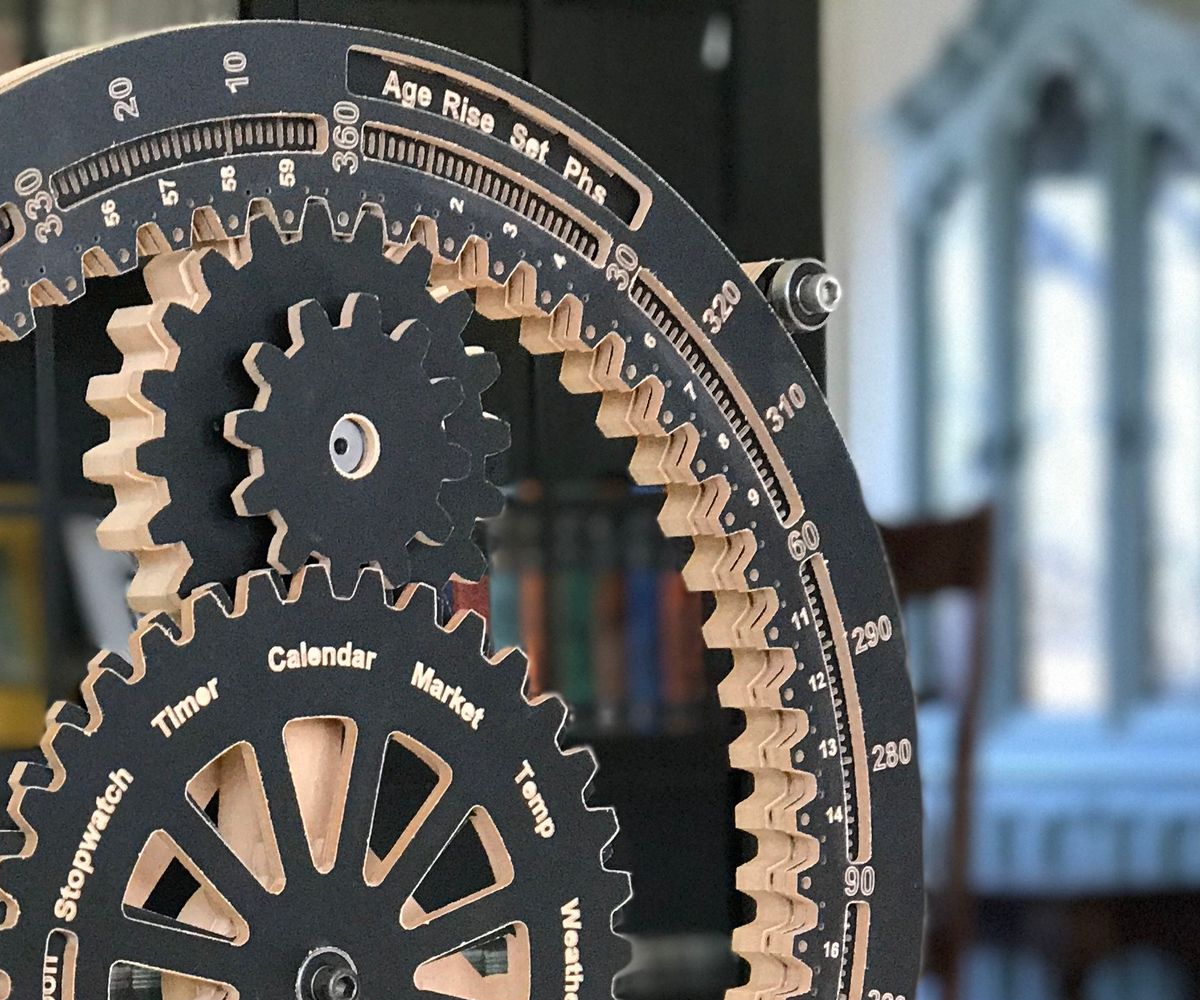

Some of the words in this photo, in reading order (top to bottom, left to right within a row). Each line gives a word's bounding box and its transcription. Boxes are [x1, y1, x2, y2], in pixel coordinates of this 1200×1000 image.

[223, 51, 249, 94] 10
[108, 76, 139, 122] 20
[332, 100, 360, 175] 360
[382, 70, 432, 109] Age
[442, 89, 495, 134] Rise
[510, 123, 549, 165] Set
[563, 155, 608, 206] Phs
[279, 158, 296, 187] 59
[14, 167, 63, 244] 330
[158, 178, 179, 206] 57
[450, 197, 464, 214] 2
[101, 199, 120, 227] 56
[503, 222, 517, 238] 3
[554, 253, 567, 269] 4
[606, 244, 638, 291] 30
[703, 280, 741, 334] 320
[644, 332, 656, 348] 6
[683, 380, 697, 401] 7
[766, 383, 806, 433] 310
[718, 432, 730, 450] 8
[748, 488, 760, 507] 9
[788, 520, 820, 561] 60
[791, 607, 809, 631] 11
[851, 614, 892, 655] 290
[267, 641, 377, 673] Calendar
[410, 660, 485, 730] Market
[809, 672, 827, 692] 12
[819, 738, 837, 759] 13
[871, 738, 912, 772] 280
[825, 805, 843, 824] 14
[54, 767, 134, 922] Stopwatch
[844, 865, 875, 896] 90
[823, 942, 839, 958] 16
